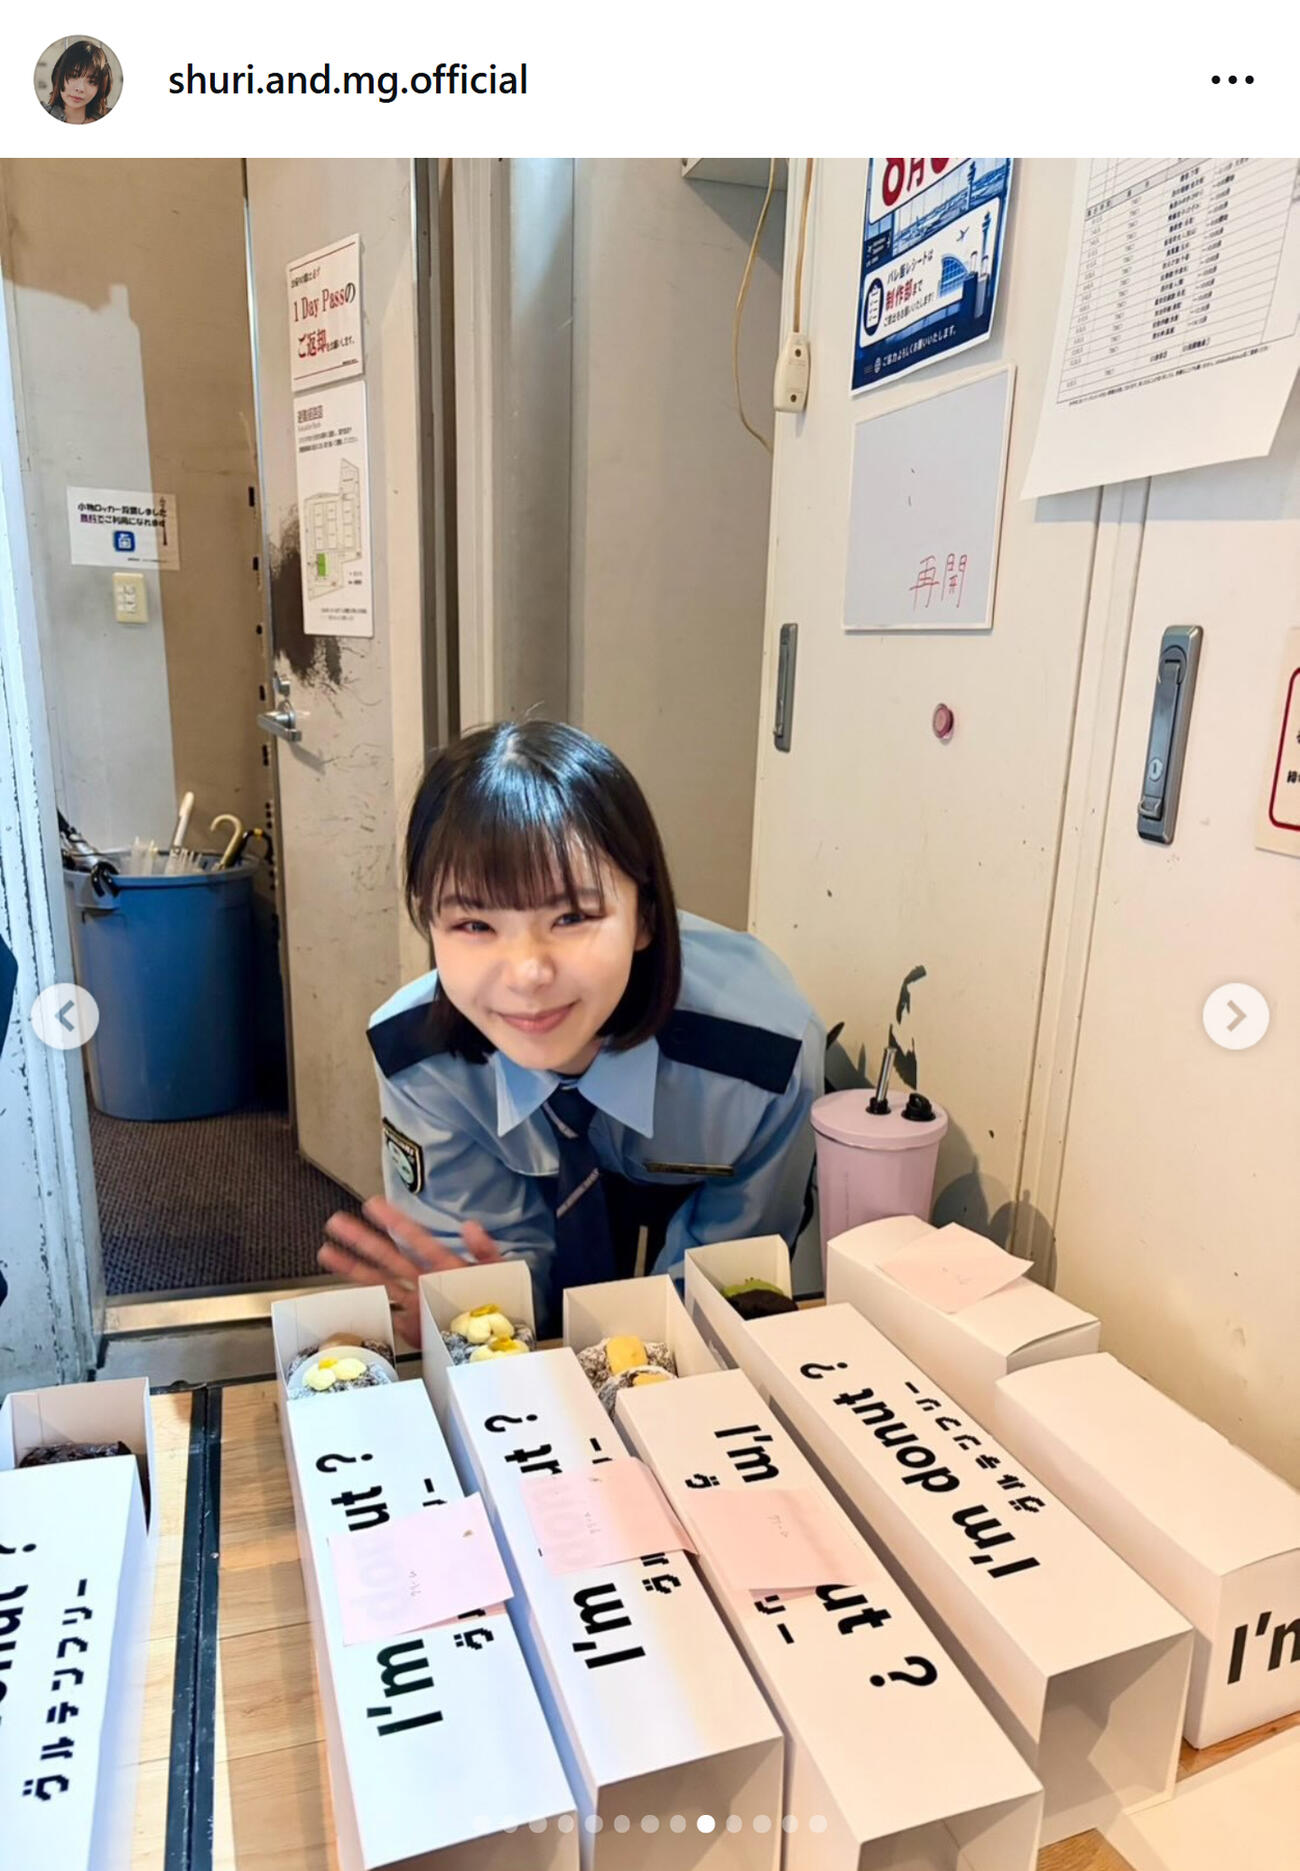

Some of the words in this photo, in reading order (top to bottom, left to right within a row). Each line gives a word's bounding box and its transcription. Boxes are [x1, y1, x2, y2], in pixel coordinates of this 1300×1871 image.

[294, 301, 300, 322] 1
[301, 297, 320, 318] Day
[909, 553, 968, 612] 再開
[800, 1362, 848, 1380] ?
[484, 1414, 538, 1433] ?
[833, 1387, 960, 1493] donut
[316, 1453, 373, 1473] ?
[714, 1424, 780, 1483] I'm
[869, 1655, 938, 1687] ?
[952, 1504, 1041, 1579] I'm
[572, 1582, 646, 1669] I'm
[22, 1578, 93, 1801] グルテンフリー
[366, 1638, 444, 1737] I'm
